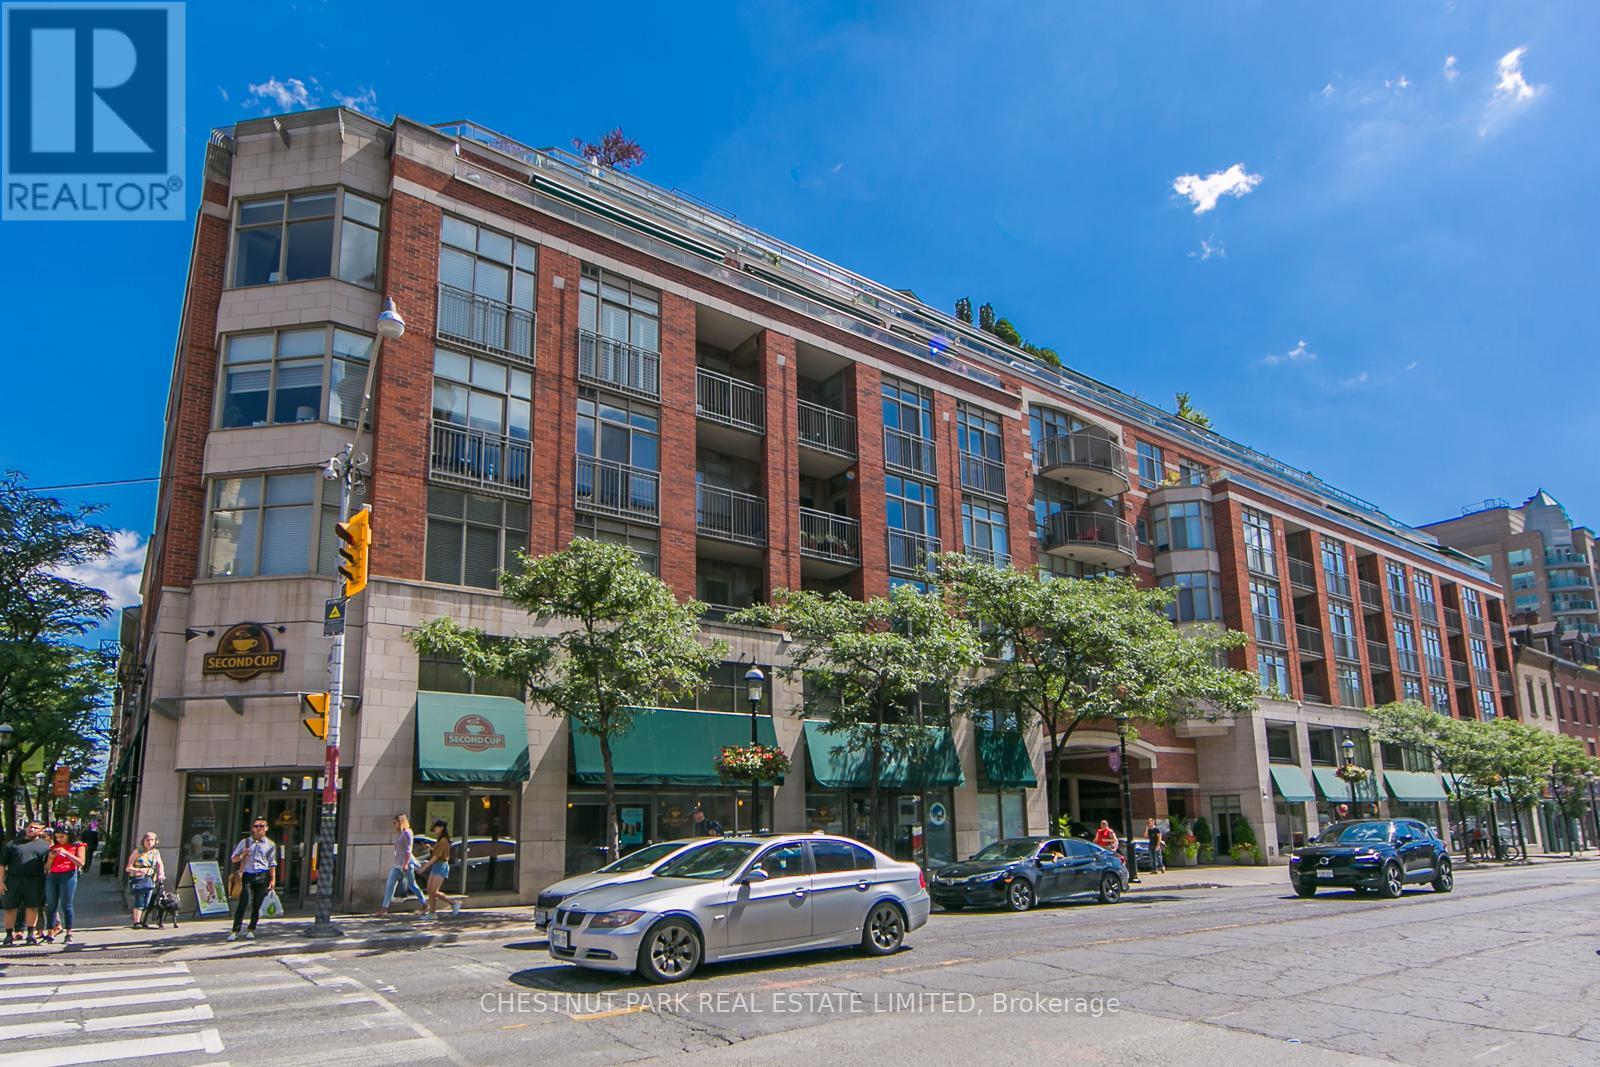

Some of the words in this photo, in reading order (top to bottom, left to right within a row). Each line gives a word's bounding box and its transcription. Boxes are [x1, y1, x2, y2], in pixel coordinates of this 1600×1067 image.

[208, 656, 252, 668] SECOND
[254, 655, 278, 666] CUP
[448, 735, 483, 744] SECOND
[484, 736, 502, 745] CUP
